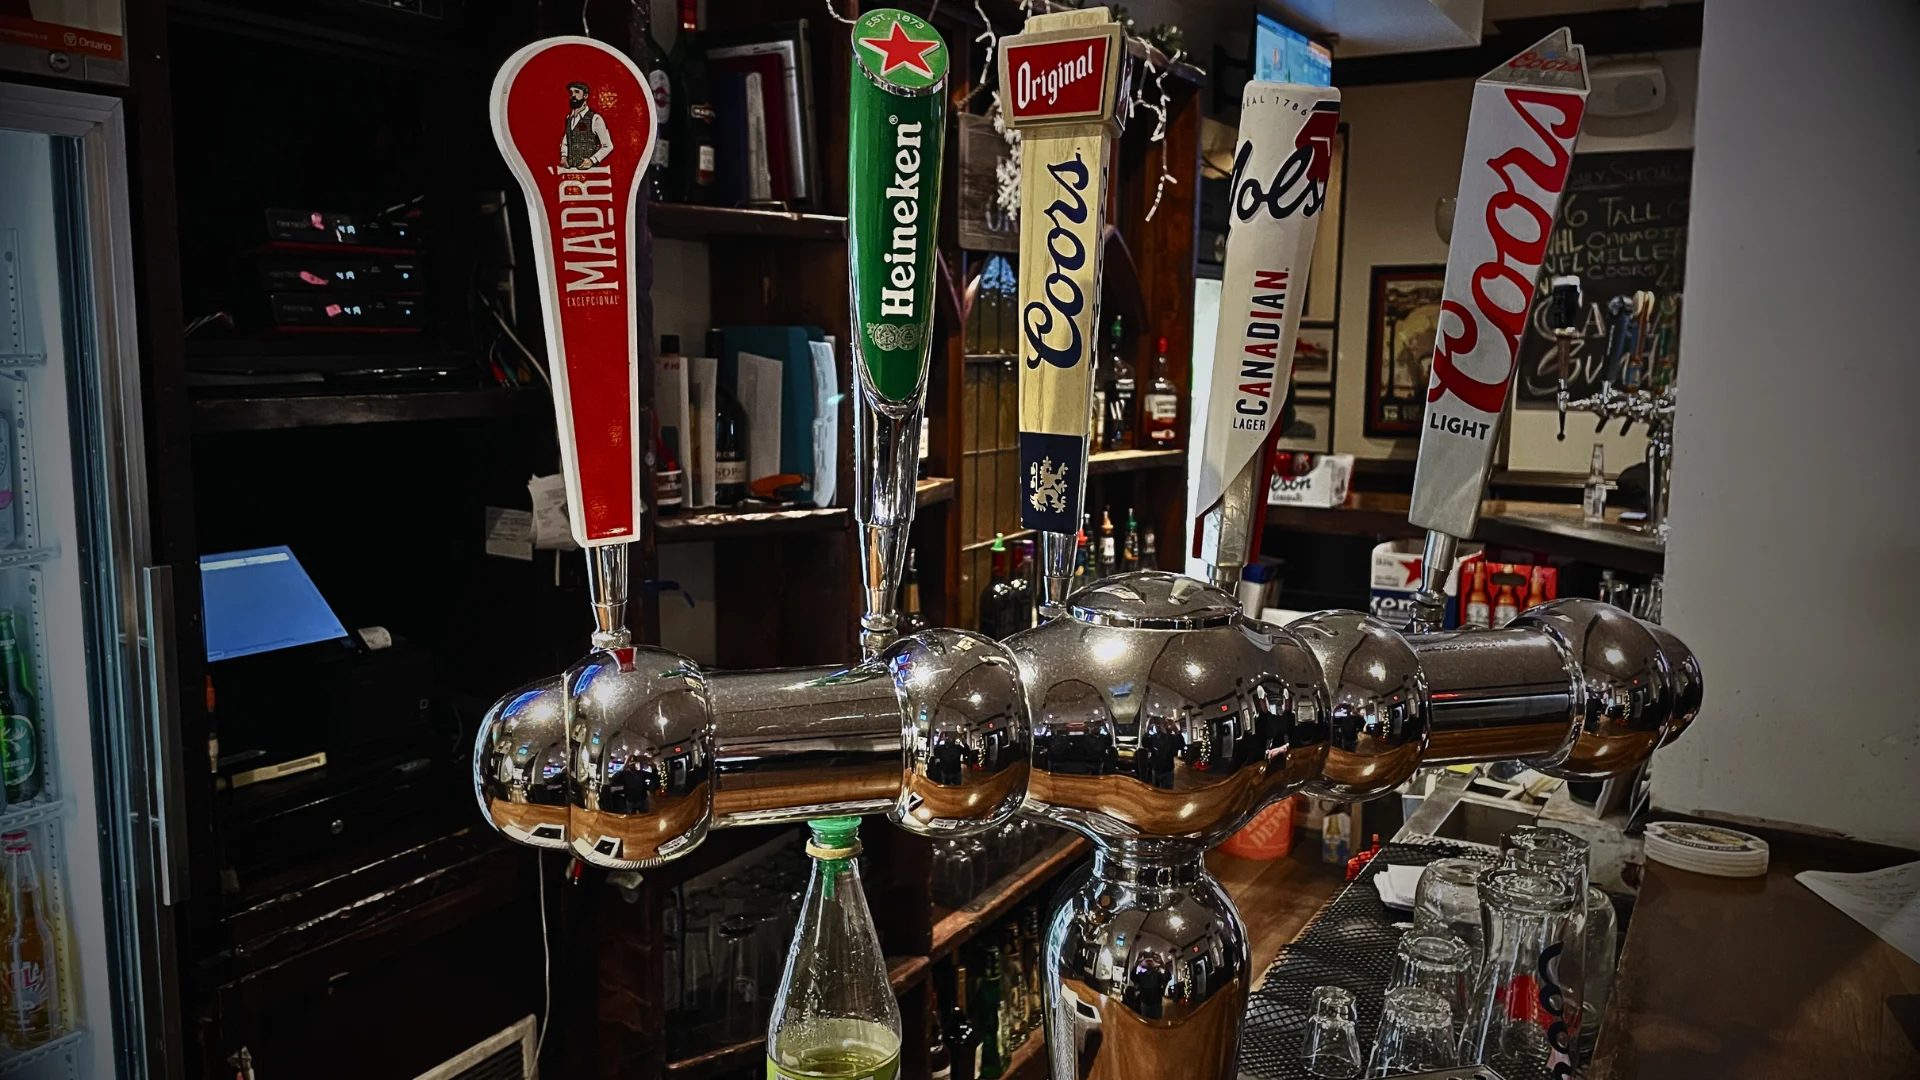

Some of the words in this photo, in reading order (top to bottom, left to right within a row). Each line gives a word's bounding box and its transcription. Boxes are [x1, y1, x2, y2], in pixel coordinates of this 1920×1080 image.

[865, 13, 891, 28] EST.
[896, 13, 925, 29] 1873
[79, 36, 112, 52] Ontario
[1017, 45, 1093, 110] Original
[1275, 96, 1308, 116] 1786
[880, 121, 922, 318] Heineken
[1597, 196, 1661, 228] TALL
[1023, 147, 1090, 370] Coors
[1428, 88, 1587, 413] Coors
[566, 295, 620, 308] EXCEPCIONAL
[1235, 269, 1290, 416] CANADIAN
[1232, 416, 1267, 432] LAGER
[1429, 412, 1491, 441] LIGHT
